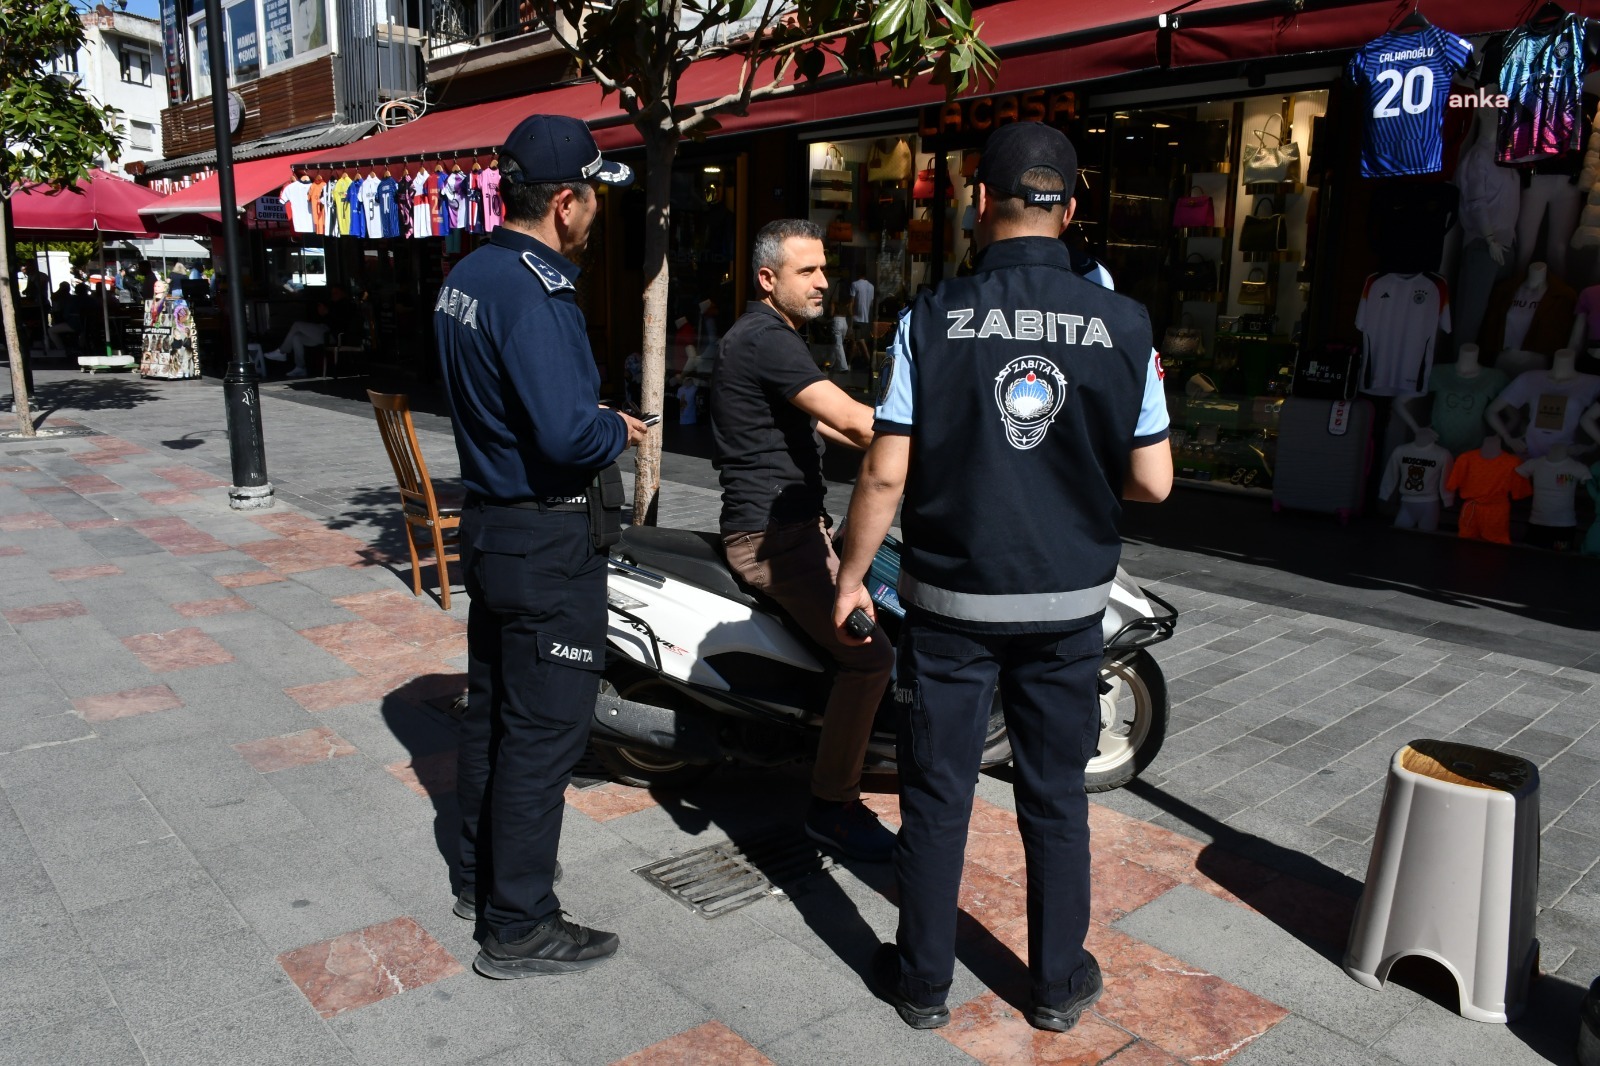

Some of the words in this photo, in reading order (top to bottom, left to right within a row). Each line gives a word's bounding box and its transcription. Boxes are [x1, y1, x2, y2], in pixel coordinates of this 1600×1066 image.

[1373, 66, 1434, 118] 20
[1034, 193, 1061, 201] ZABITA
[434, 286, 478, 330] ABITA
[947, 308, 1113, 348] ZABITA
[1012, 360, 1052, 376] ZABITA
[546, 496, 587, 504] ZABITA
[550, 642, 593, 662] ZABITA
